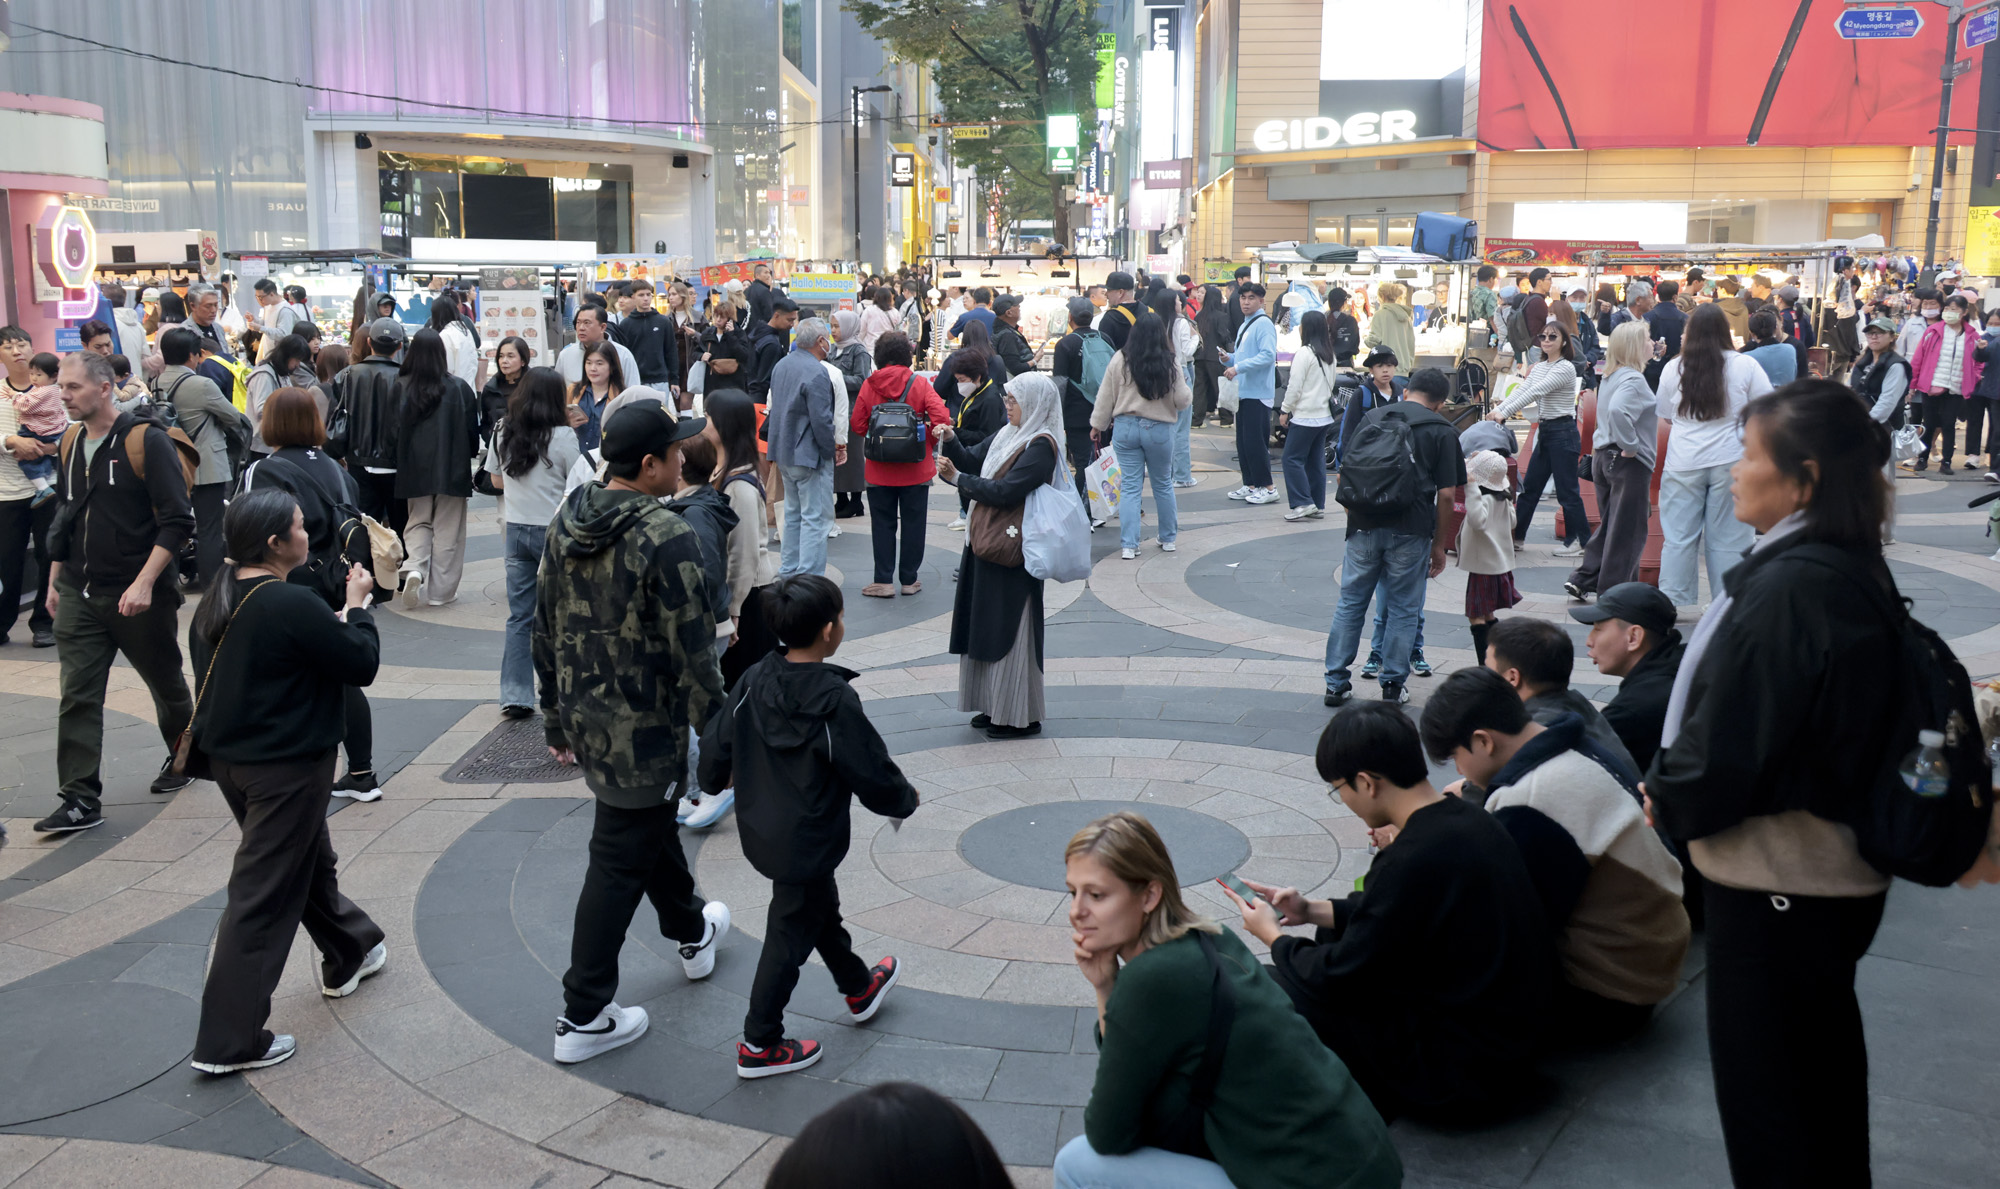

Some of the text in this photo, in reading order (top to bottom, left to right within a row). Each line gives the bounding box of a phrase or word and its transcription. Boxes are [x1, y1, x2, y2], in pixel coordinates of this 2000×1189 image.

[1867, 12, 1892, 22] 명동길
[1097, 34, 1115, 43] ABC
[953, 129, 968, 137] CCTV
[1253, 110, 1417, 152] EIDER
[1149, 170, 1181, 180] ETUDE
[1970, 209, 1990, 220] 입구
[815, 277, 854, 291] Massage
